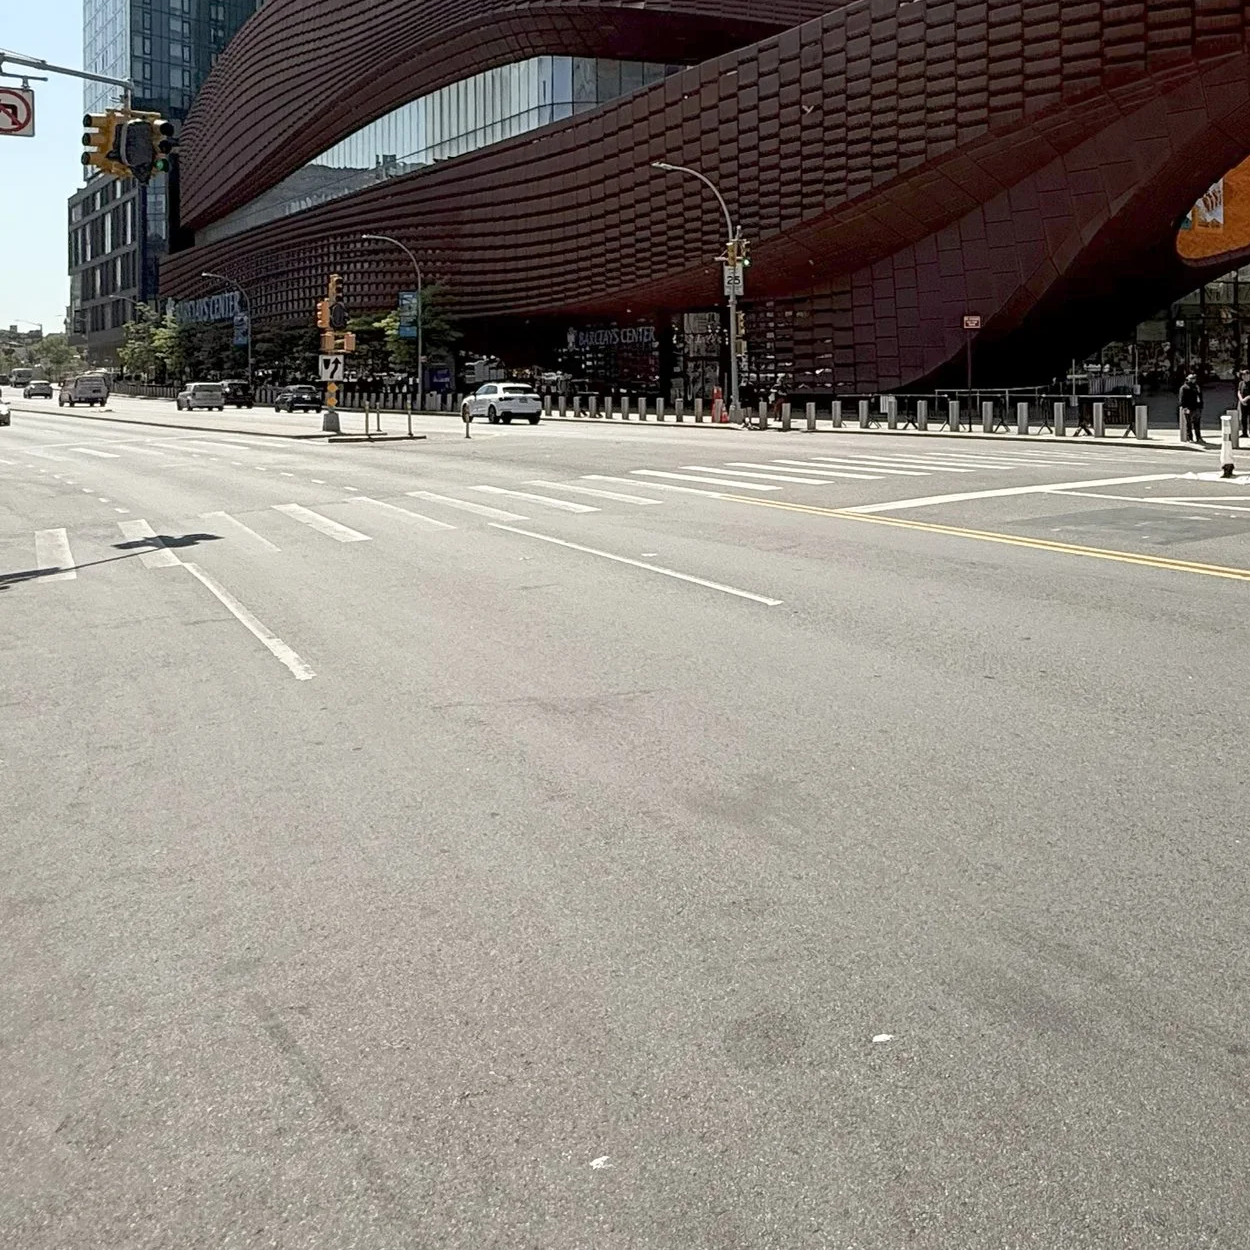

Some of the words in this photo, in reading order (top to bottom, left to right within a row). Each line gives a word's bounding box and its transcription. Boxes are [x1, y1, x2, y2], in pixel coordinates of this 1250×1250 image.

[726, 275, 741, 285] 25
[578, 328, 620, 346] BARCLAYS
[620, 325, 656, 343] CENTER
